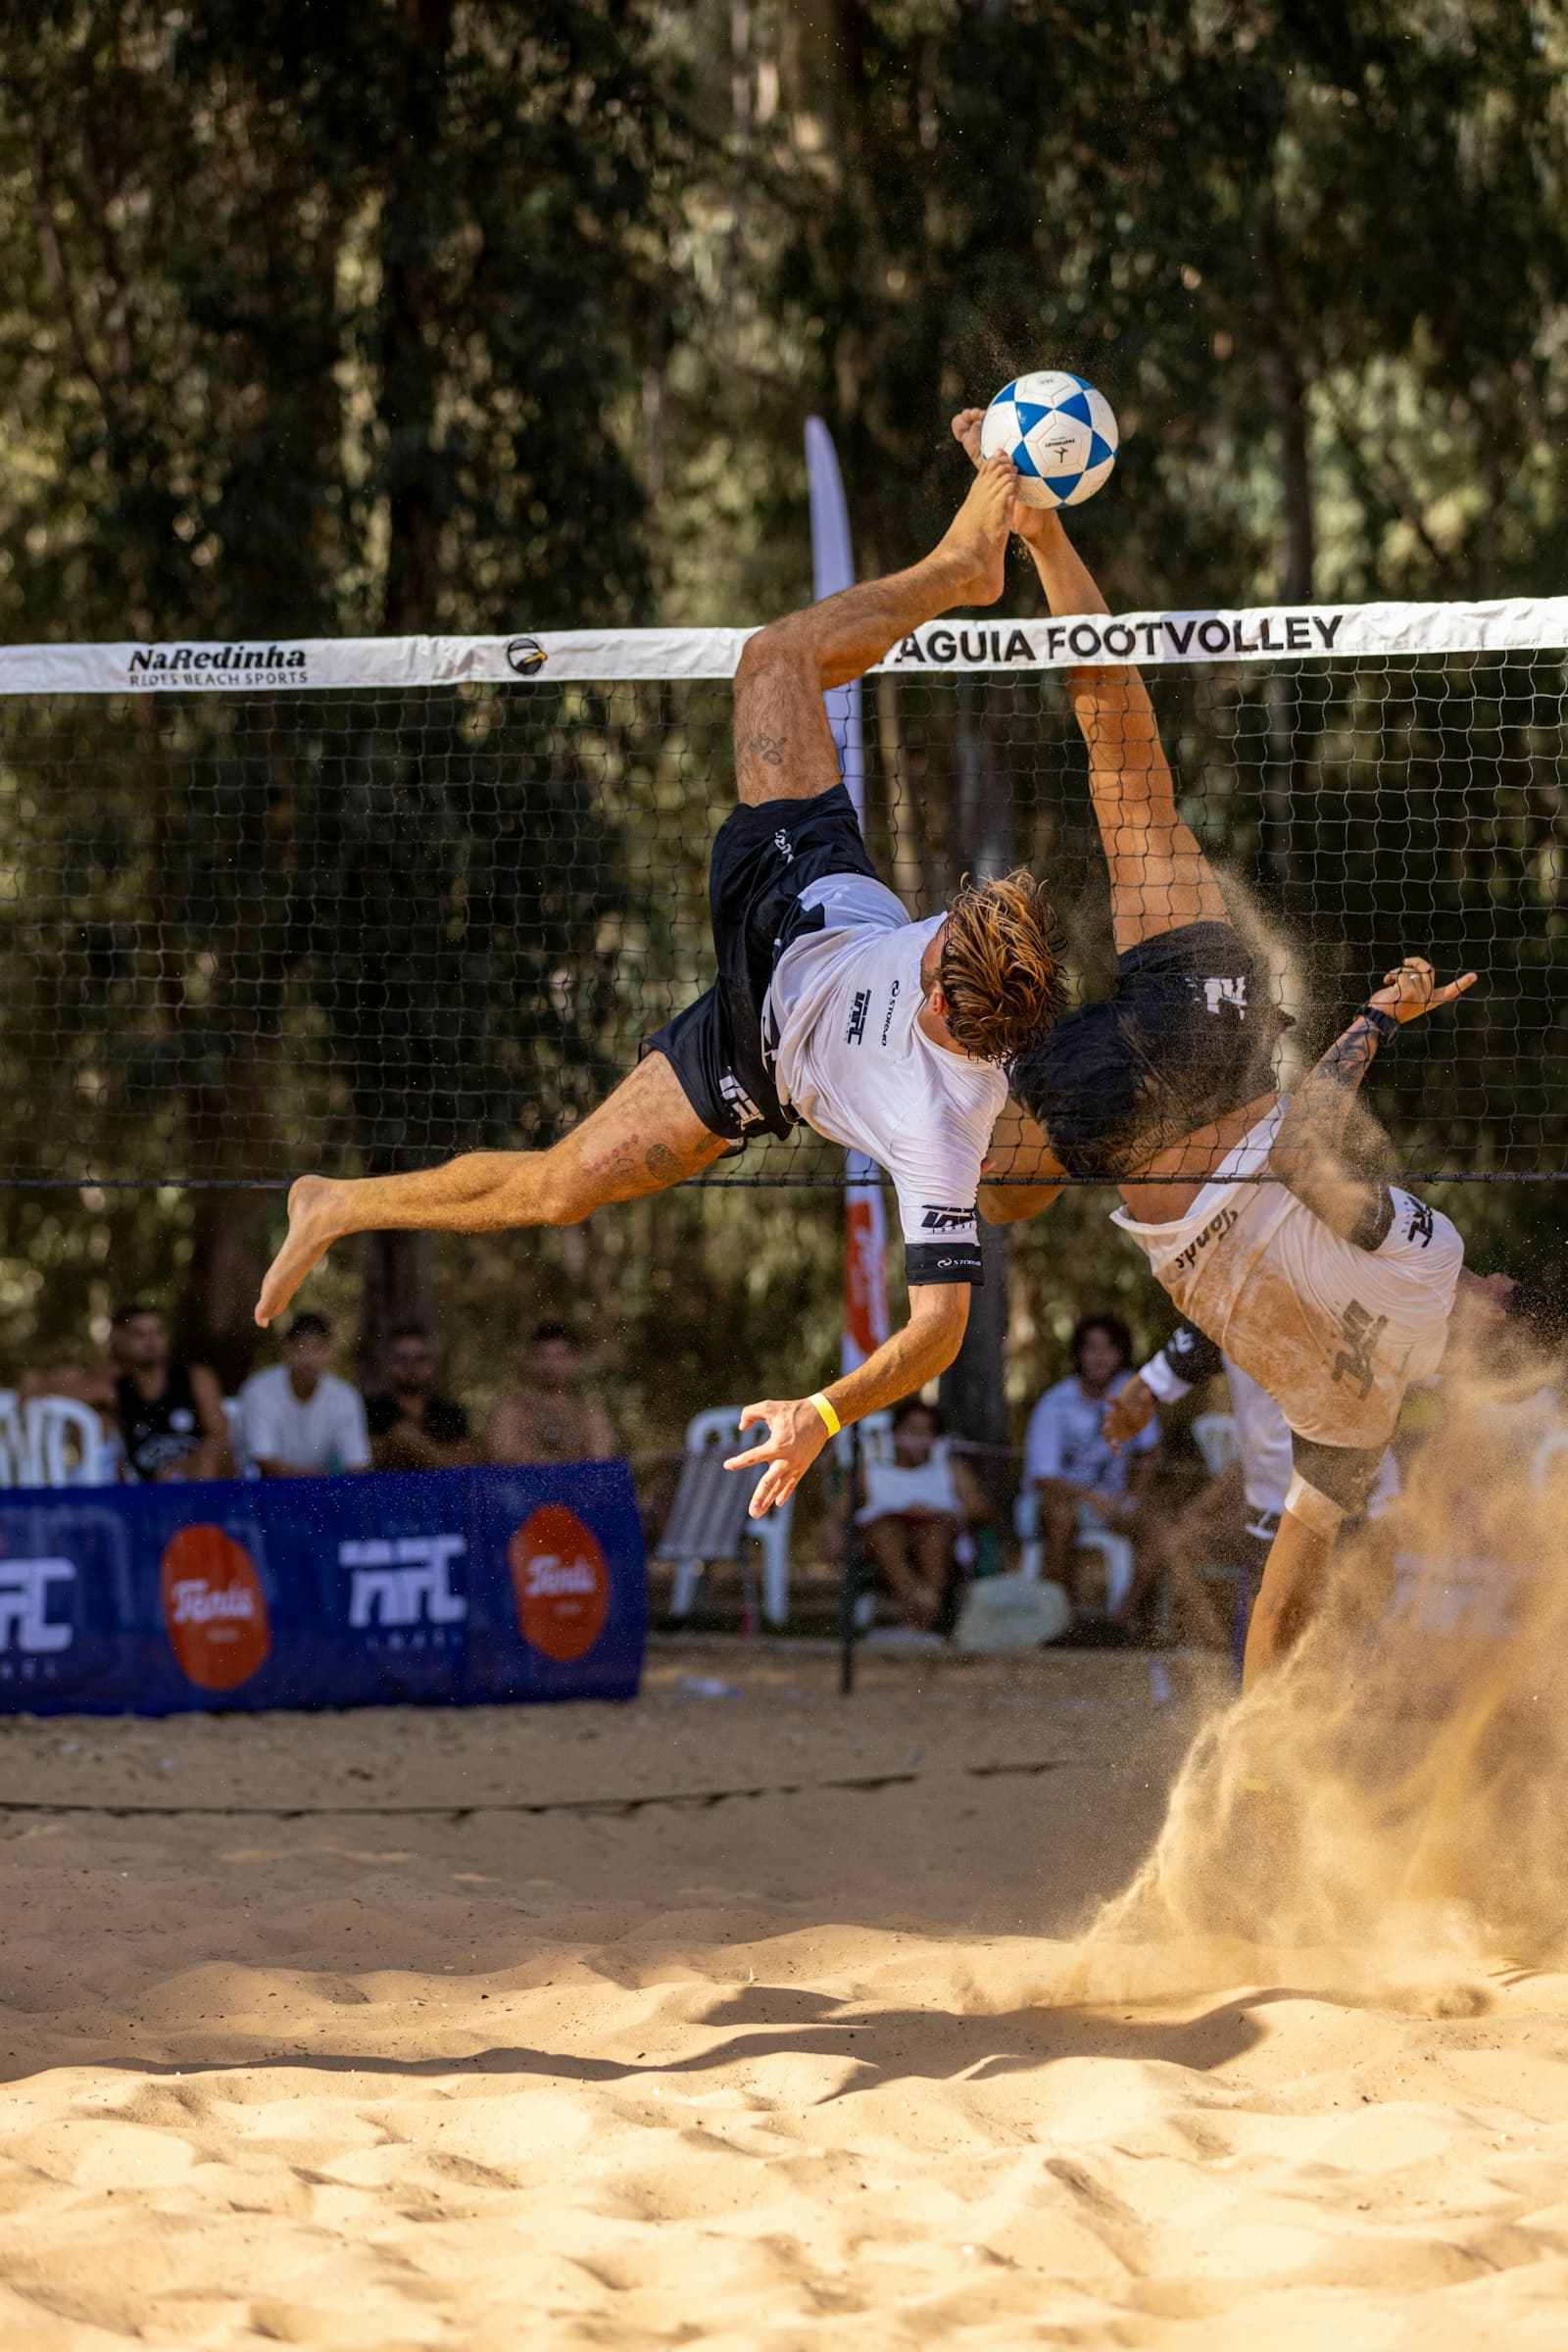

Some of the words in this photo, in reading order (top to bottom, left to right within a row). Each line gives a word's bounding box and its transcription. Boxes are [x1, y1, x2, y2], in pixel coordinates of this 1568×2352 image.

[894, 628, 1037, 663] AGUIA
[1047, 614, 1344, 661] FOOTVOLLEY
[128, 644, 307, 672] NaRedinha
[183, 671, 240, 686] BEACH
[244, 670, 309, 685] SPORTS
